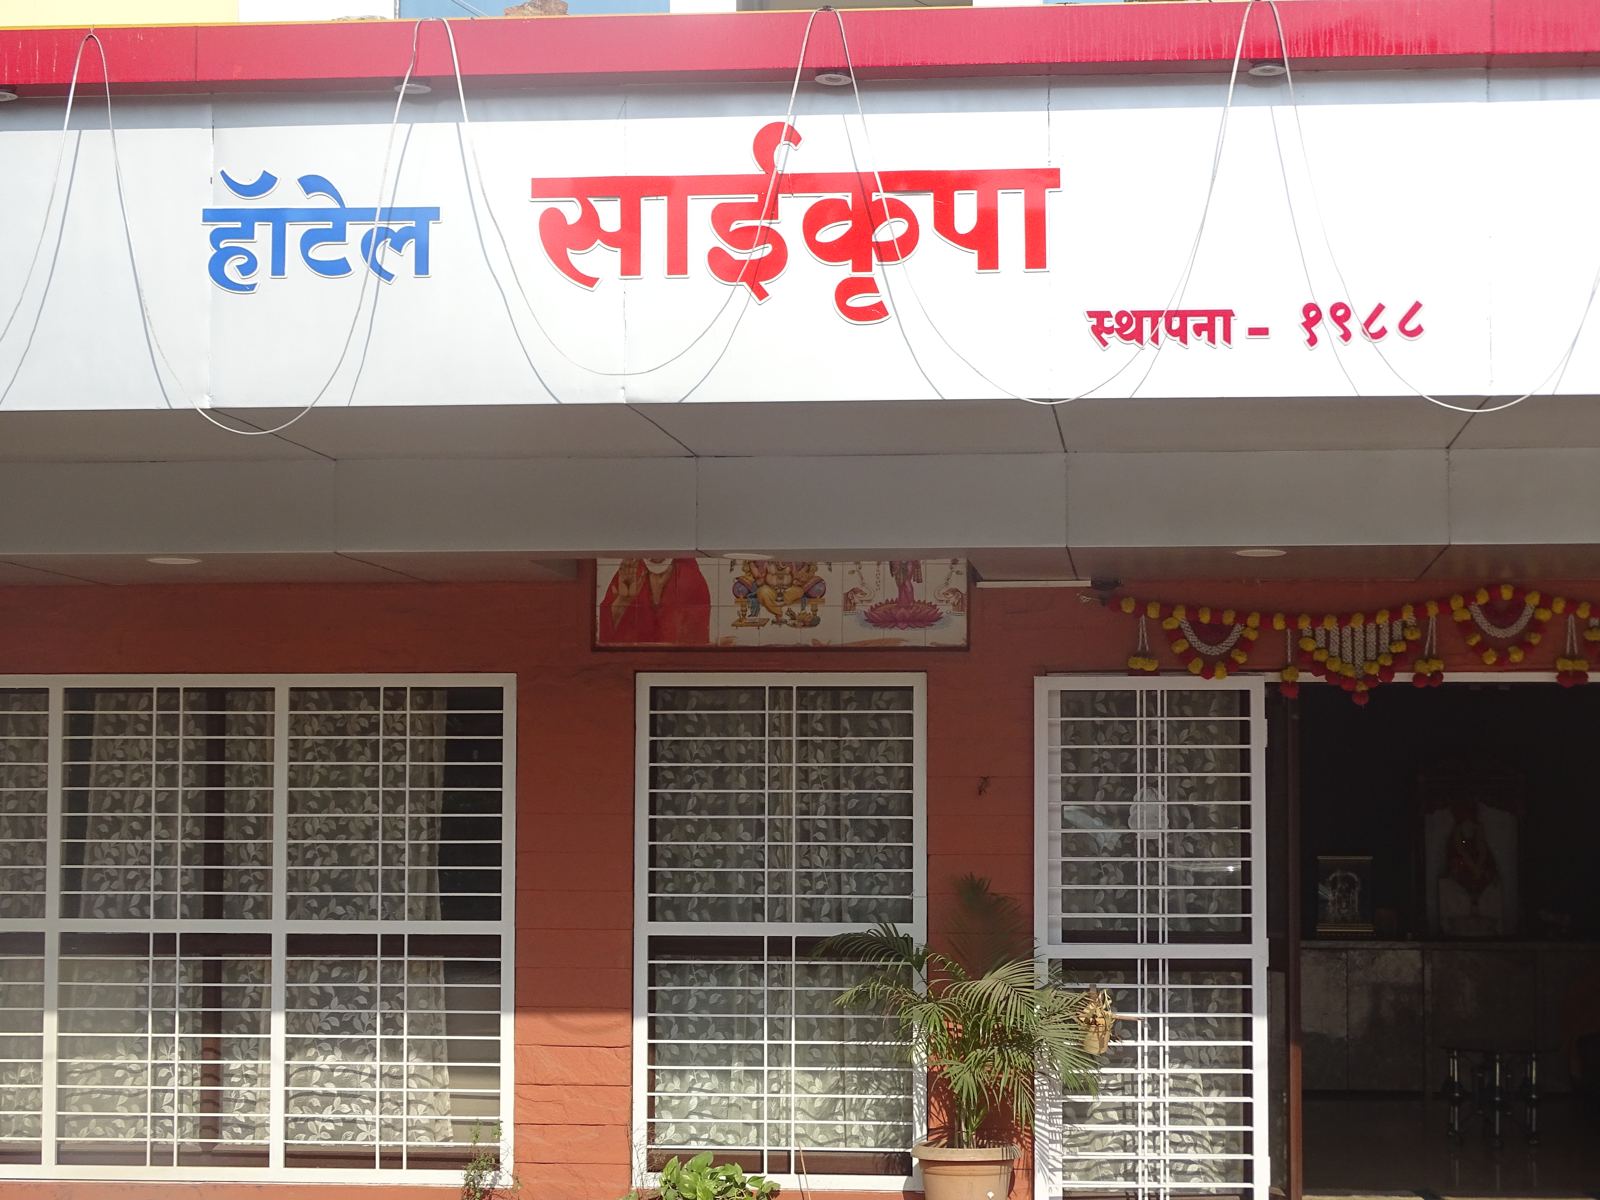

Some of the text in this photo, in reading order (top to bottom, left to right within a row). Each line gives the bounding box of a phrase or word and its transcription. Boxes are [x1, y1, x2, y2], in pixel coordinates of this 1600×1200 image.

[202, 121, 1061, 322] हॉटेल साईकृपा
[1086, 309, 1235, 348] स्थापना
[1301, 301, 1424, 347] १९८८
